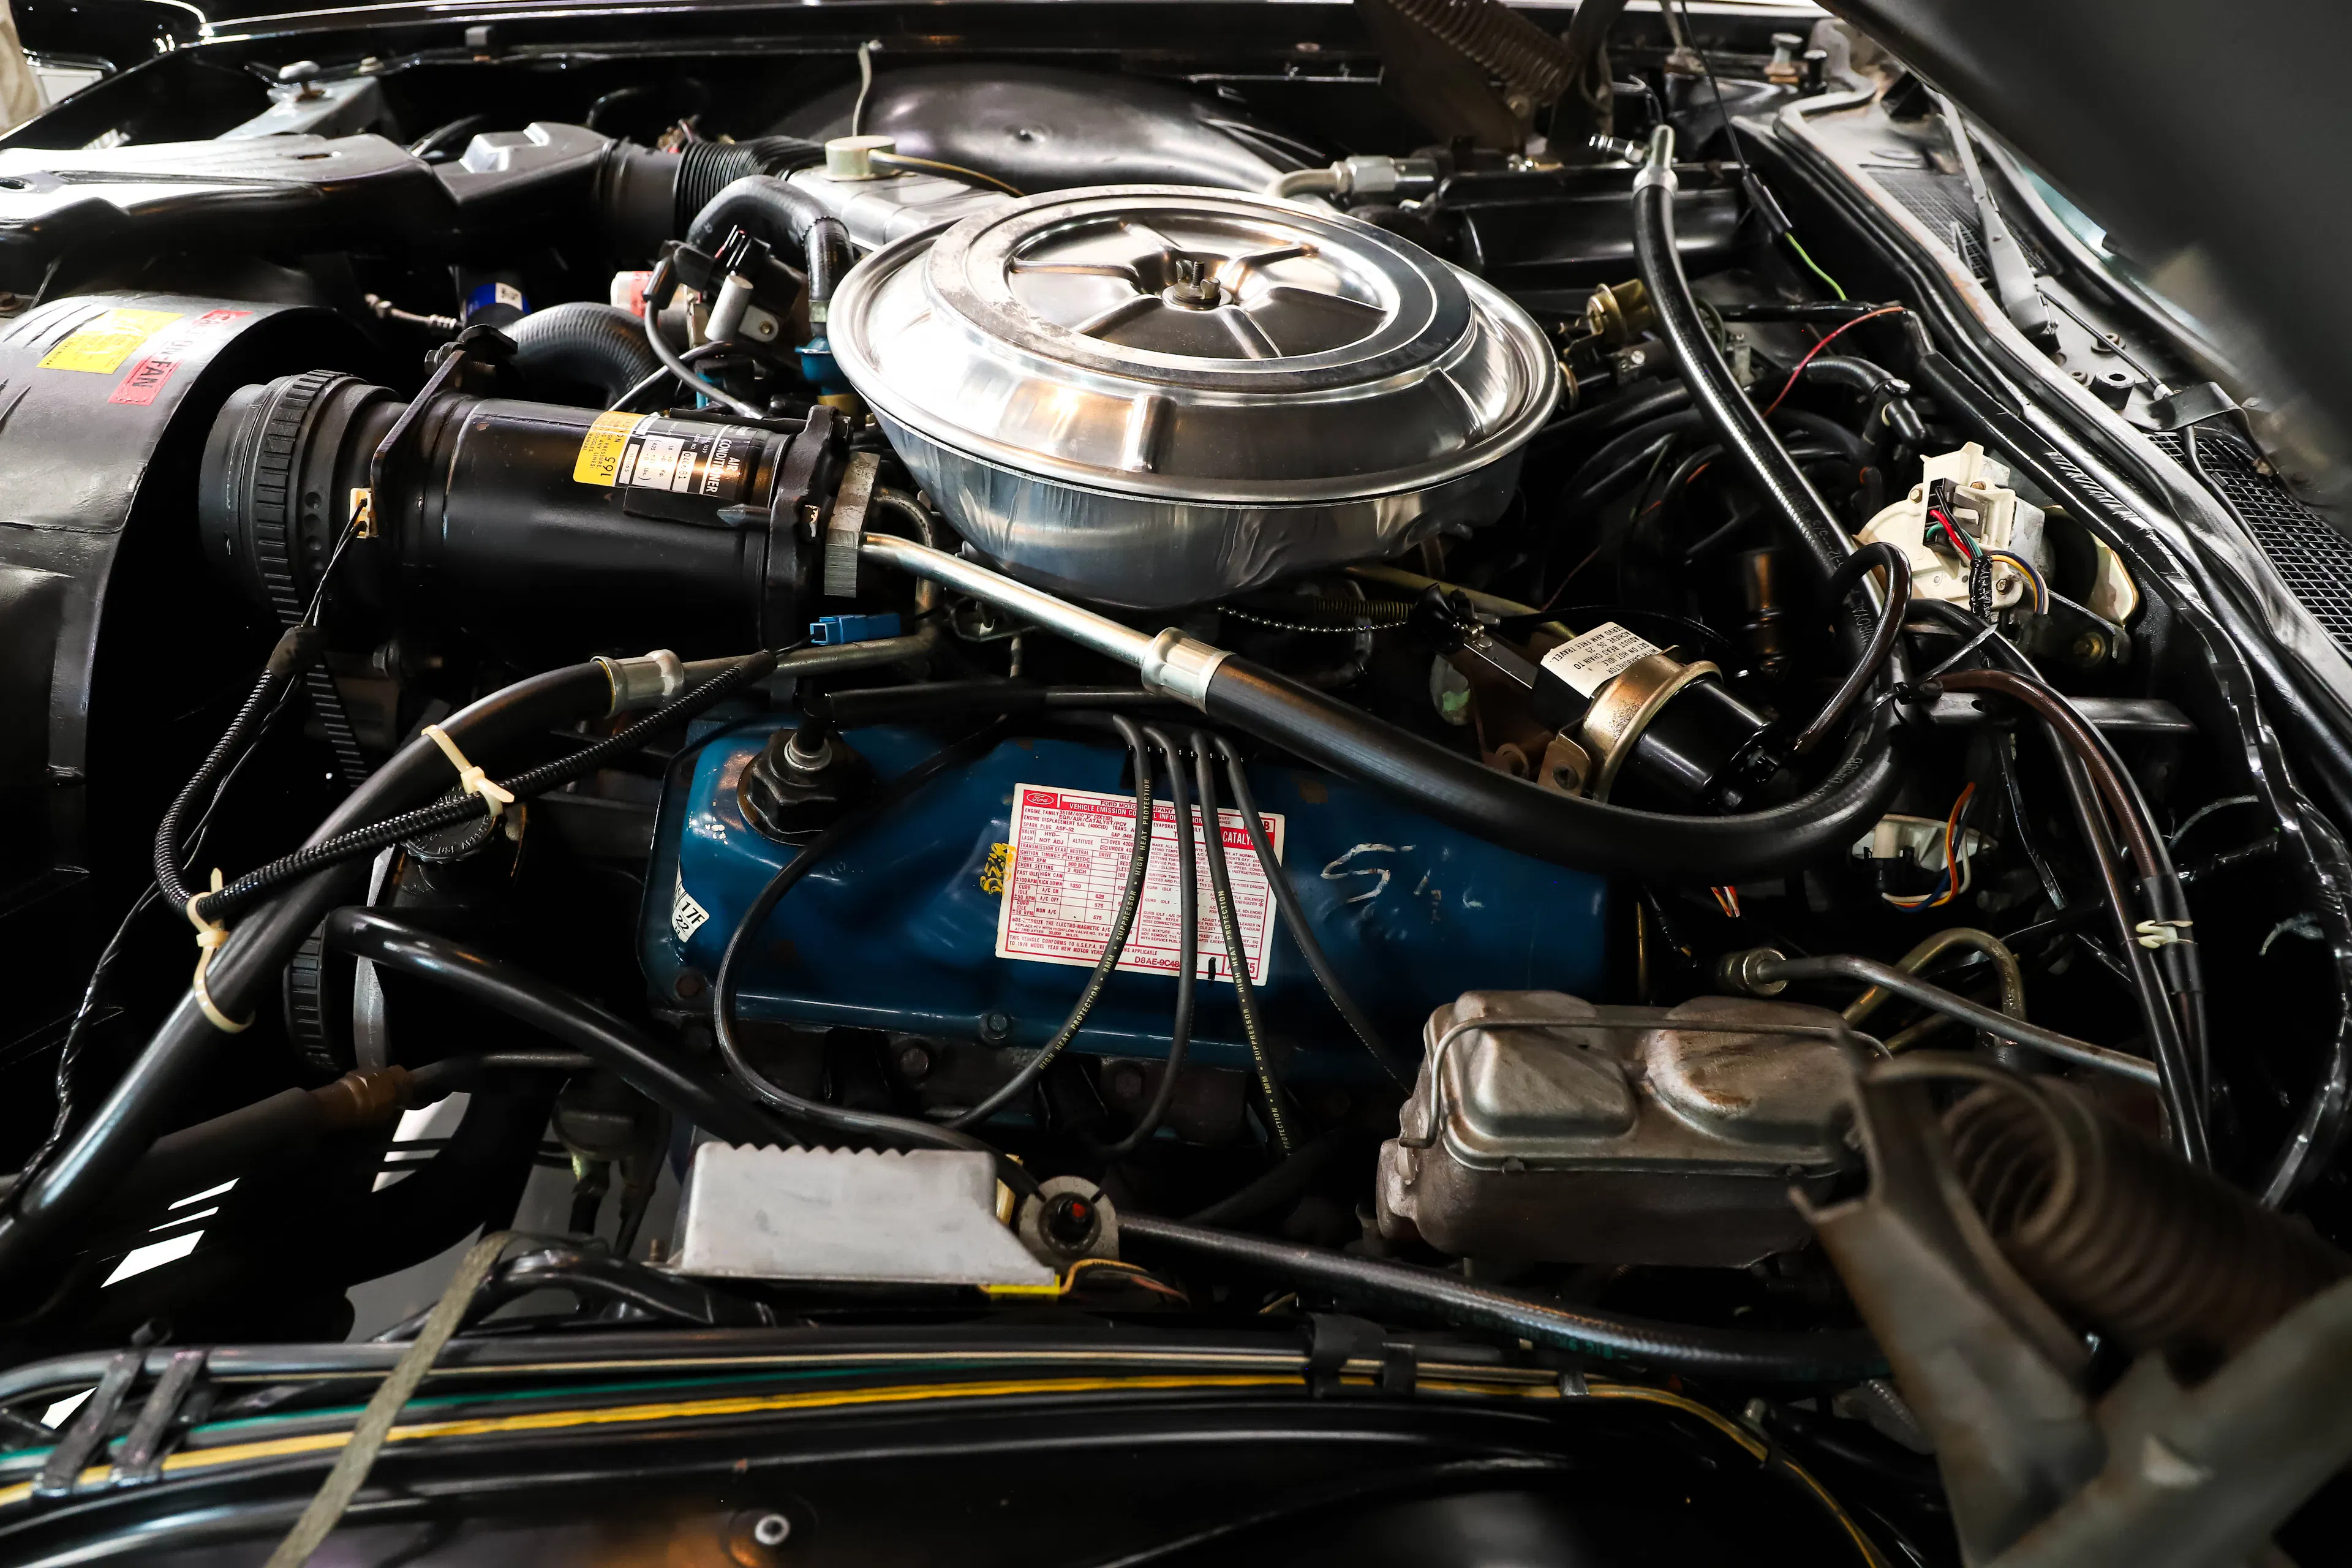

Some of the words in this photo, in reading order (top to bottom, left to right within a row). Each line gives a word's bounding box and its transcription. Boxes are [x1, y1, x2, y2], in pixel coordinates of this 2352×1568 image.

[706, 439, 732, 492] CONDITIONER
[726, 457, 741, 471] AIR
[1607, 631, 1630, 644] ACHIEVE
[1618, 636, 1640, 647] ADJUST
[1604, 646, 1617, 655] BEAD
[1584, 653, 1603, 663] CHAIN
[1604, 658, 1616, 666] IDLE
[1032, 794, 1049, 803] Ford
[1020, 843, 1054, 852] TRANSMISSION
[682, 901, 704, 924] 17F
[1218, 890, 1232, 940] PROTECTION
[1056, 922, 1100, 931] ELECTRO-MAGNETIC
[1039, 1053, 1055, 1069] HIGH
[1055, 1032, 1071, 1050] HEAT
[1070, 985, 1101, 1030] PROTECTION
[1103, 954, 1115, 973] 8MM
[1116, 890, 1137, 941] SUPPRESSOR
[1134, 856, 1144, 875] HIGH
[1139, 831, 1148, 850] HEAT
[1229, 946, 1238, 967] HEAT
[1235, 973, 1245, 993] HIGH
[1243, 1008, 1262, 1060] SUPPRESSOR
